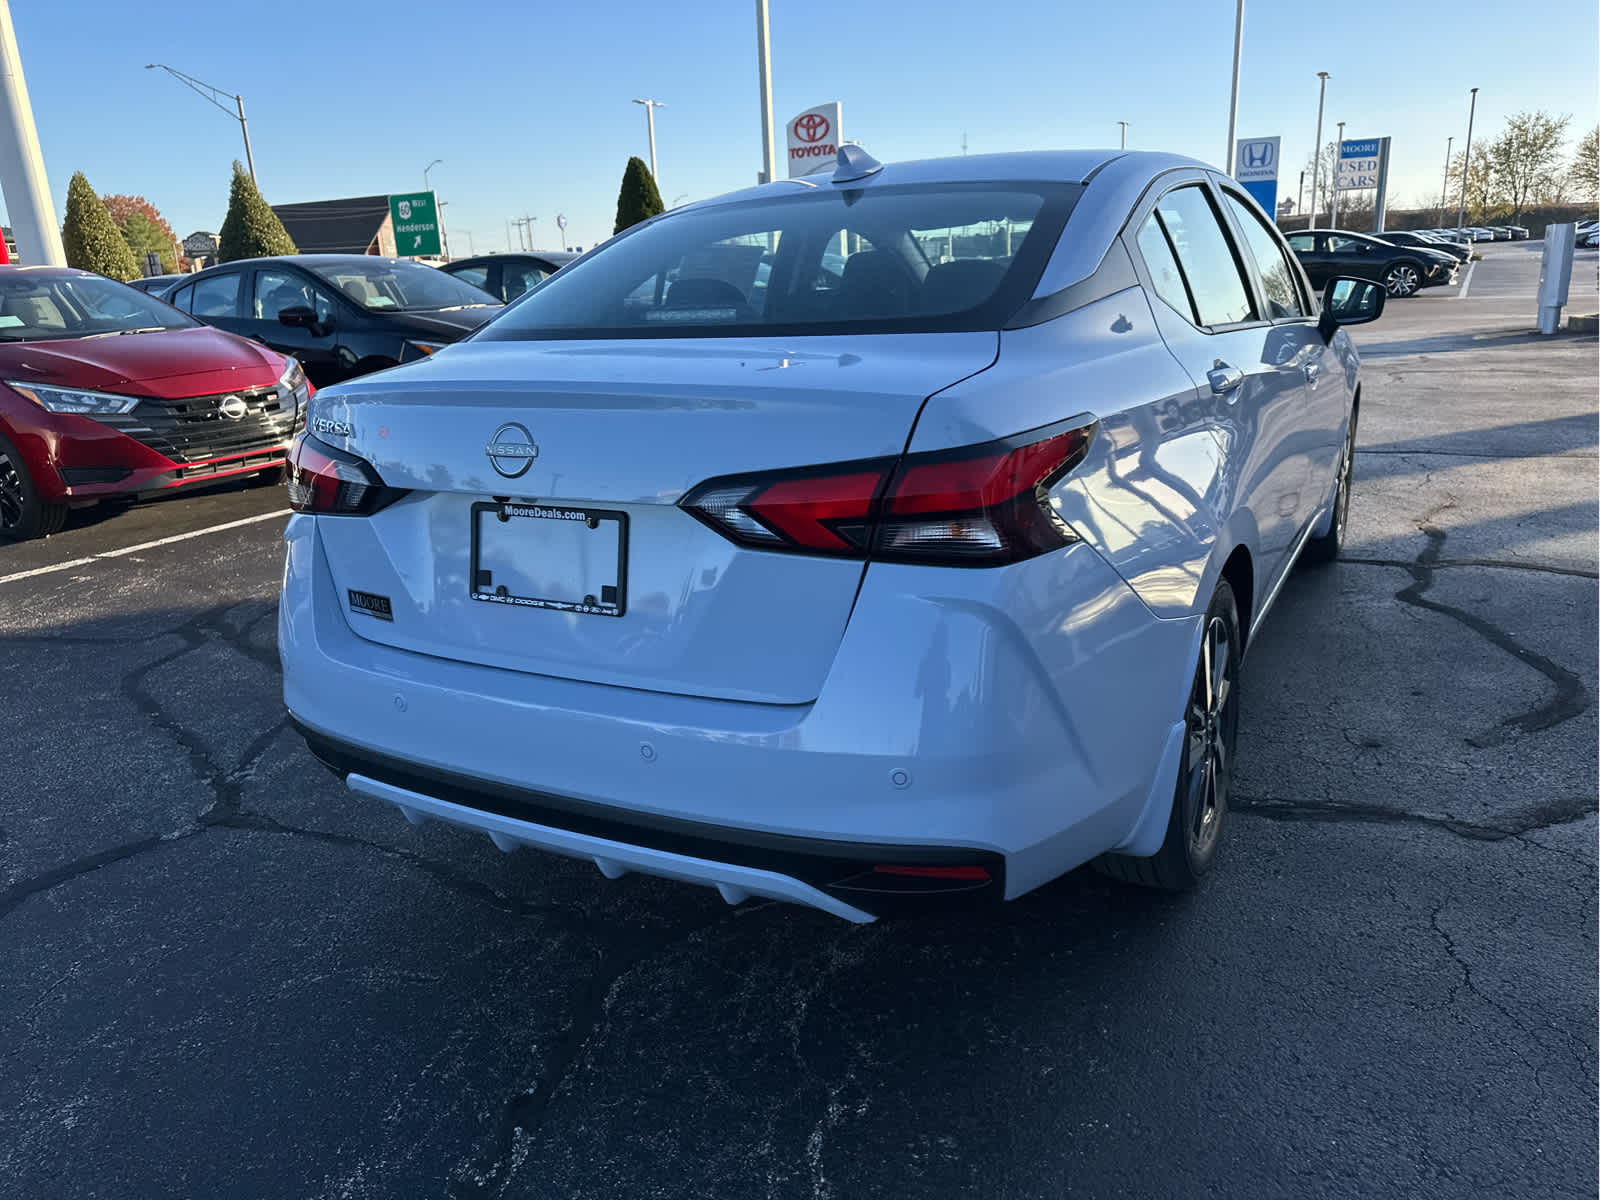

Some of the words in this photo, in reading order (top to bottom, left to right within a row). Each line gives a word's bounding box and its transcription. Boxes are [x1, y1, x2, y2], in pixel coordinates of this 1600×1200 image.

[789, 144, 837, 159] TOYOTA
[1342, 143, 1377, 153] MOORE
[1339, 160, 1377, 173] USED
[1239, 169, 1275, 177] HONDA
[1337, 175, 1376, 187] CARS
[400, 204, 410, 216] 60
[396, 223, 435, 232] Henderson
[312, 416, 356, 438] VERSA
[486, 445, 537, 456] NISSAN
[504, 505, 586, 521] MooreDeals.com
[351, 592, 389, 612] MOORE
